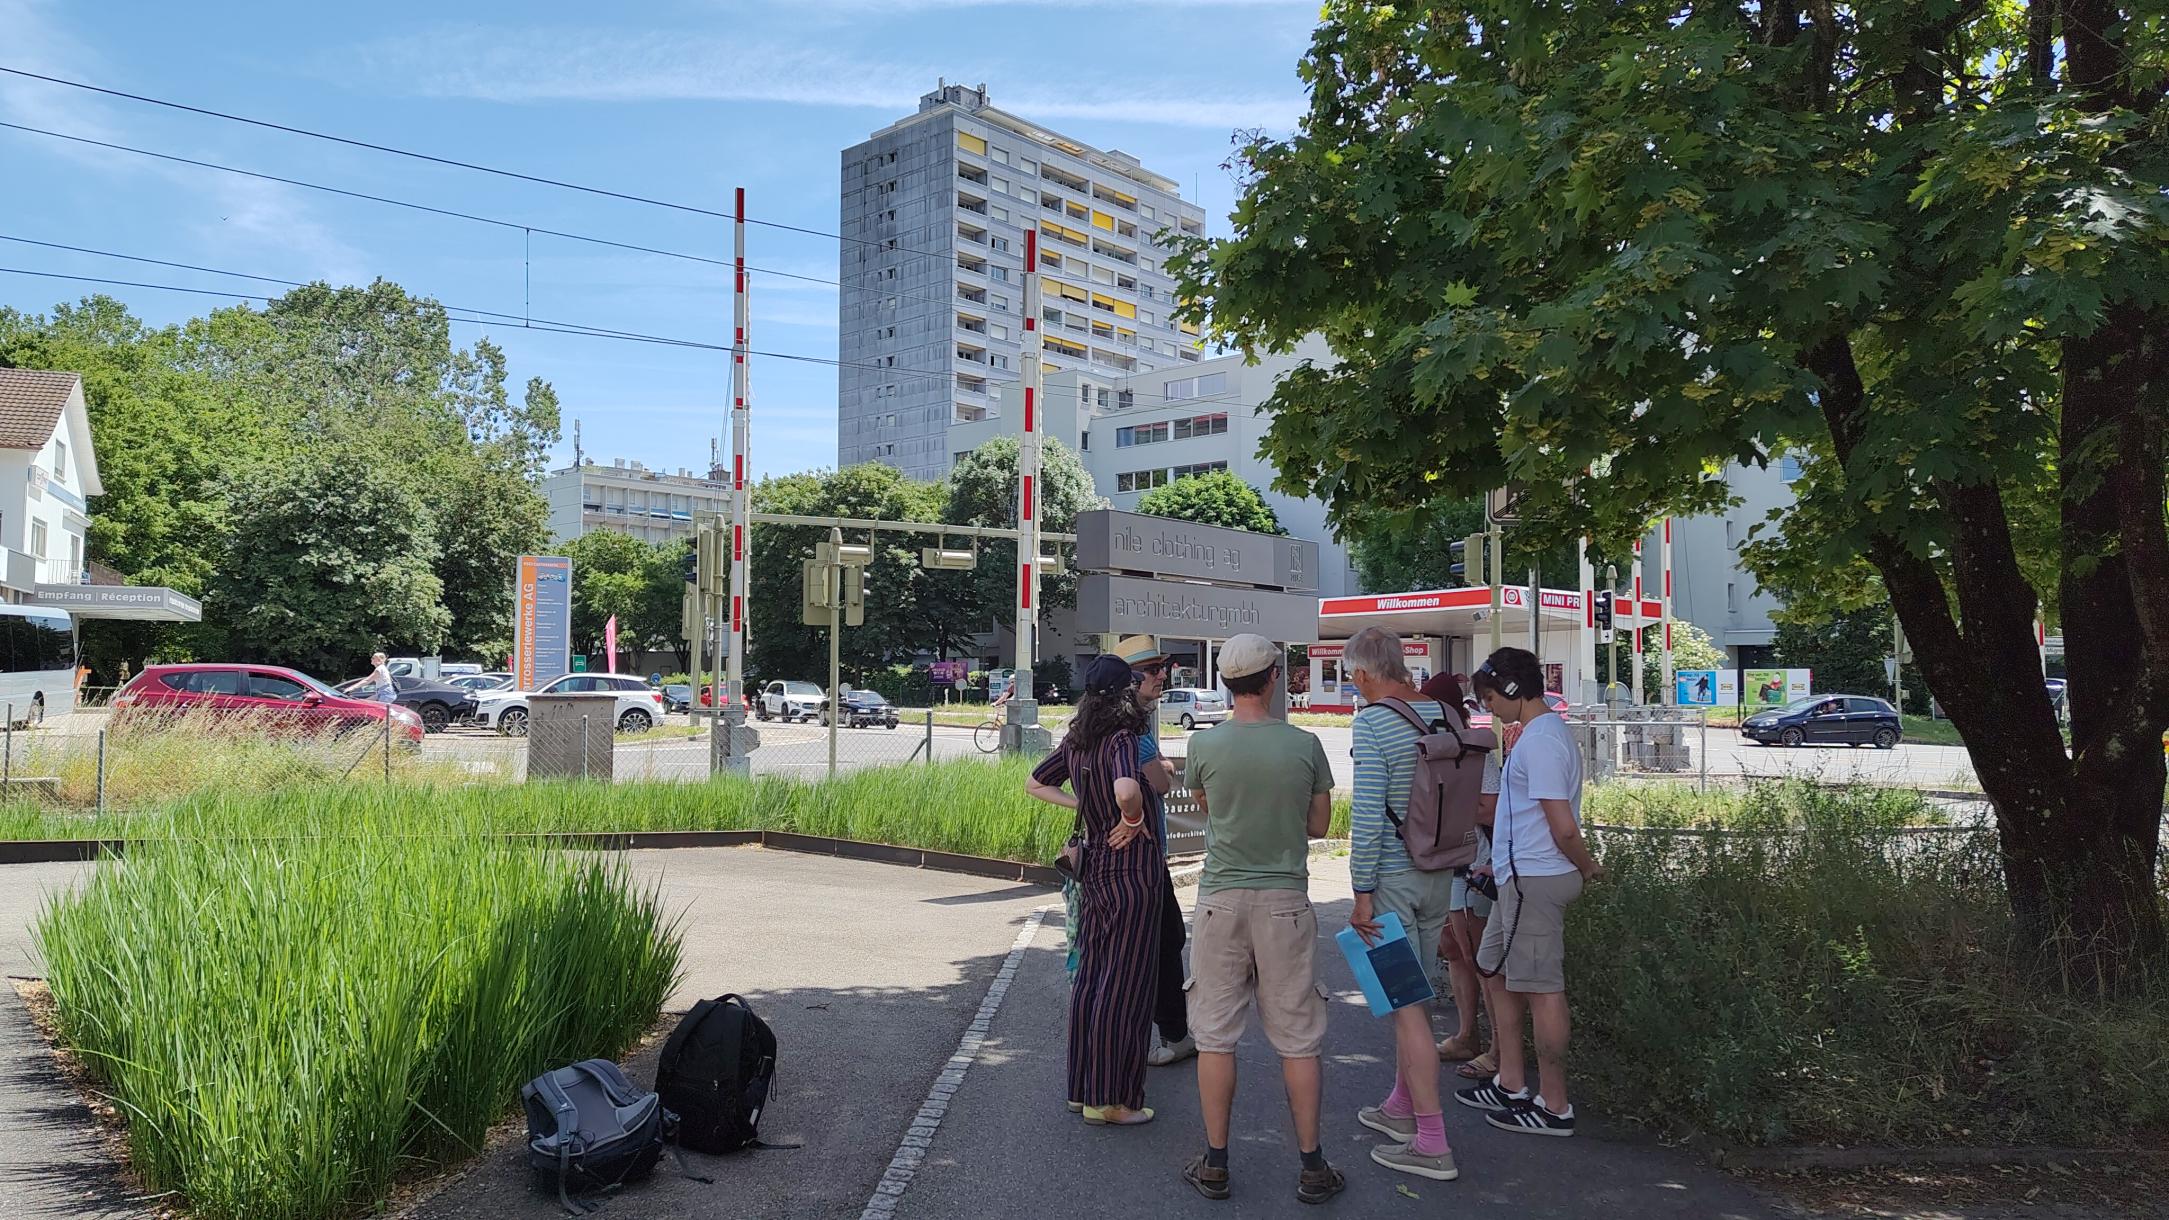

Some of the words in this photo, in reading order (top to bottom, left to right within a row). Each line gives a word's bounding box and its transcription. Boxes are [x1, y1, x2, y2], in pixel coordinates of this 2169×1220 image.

[1114, 526, 1143, 554] nile
[1152, 530, 1215, 569] clothing
[1223, 547, 1241, 573] ag
[37, 591, 92, 601] Empfang
[101, 590, 161, 603] Réception
[523, 583, 534, 601] AG
[1376, 597, 1440, 610] Willkommen
[1543, 593, 1565, 606] MINI
[1566, 596, 1580, 607] PR
[1115, 591, 1260, 630] architekturgmbh
[523, 603, 534, 691] arrosseriewerke
[1311, 648, 1344, 656] Willkomm
[1163, 786, 1192, 799] archi
